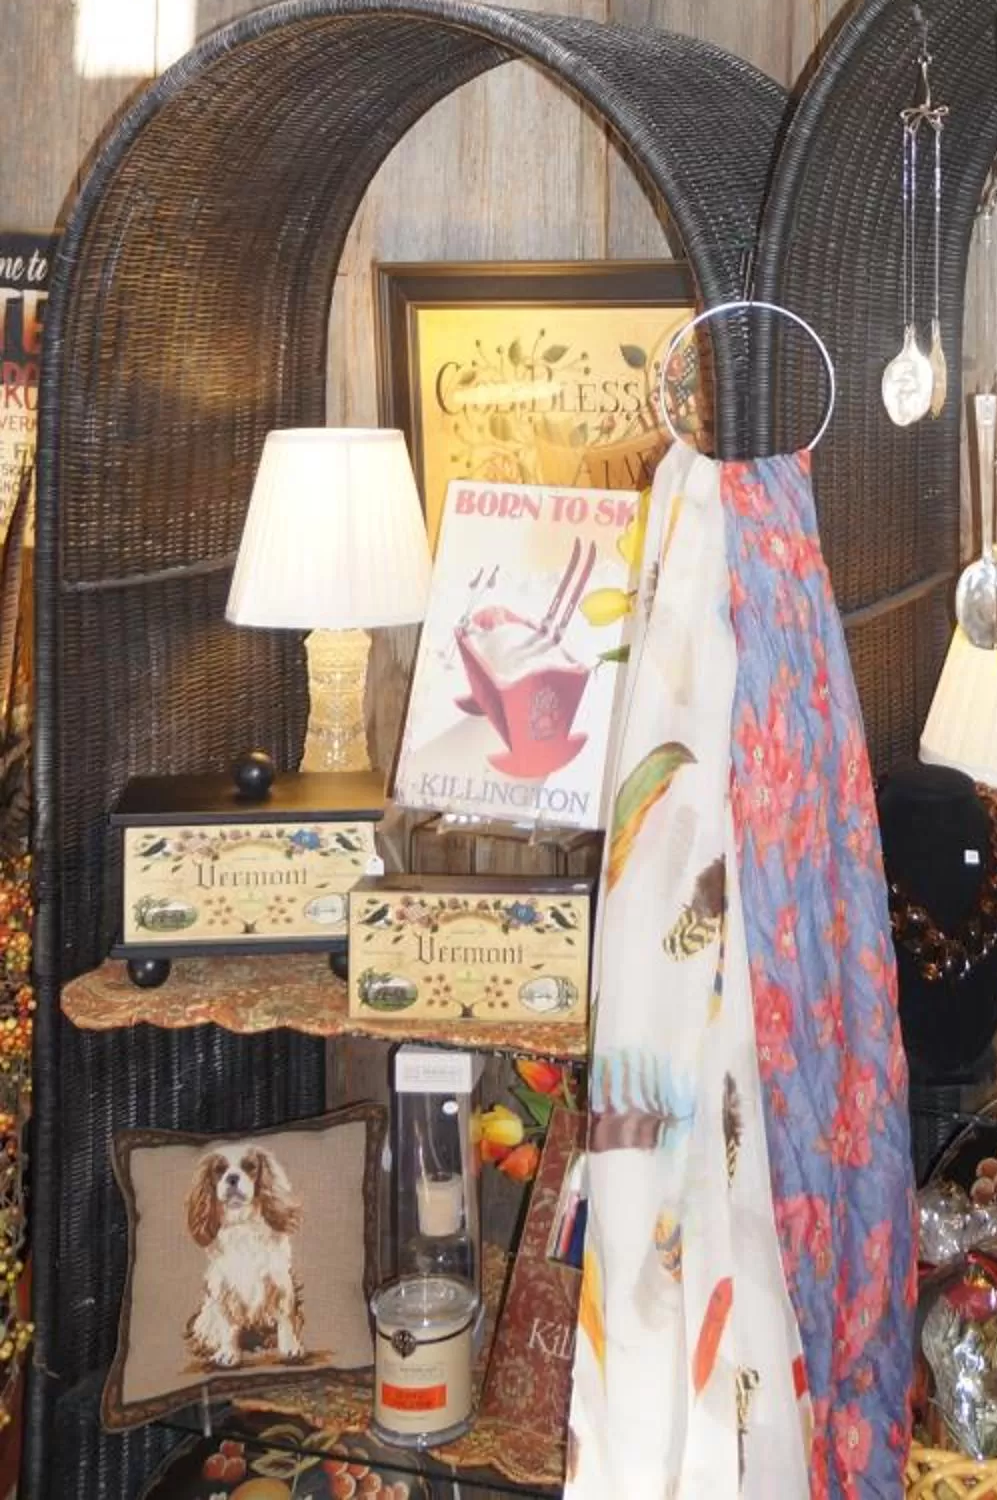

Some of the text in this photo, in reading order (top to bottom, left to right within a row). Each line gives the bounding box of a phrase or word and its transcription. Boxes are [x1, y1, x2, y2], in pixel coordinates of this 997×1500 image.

[455, 488, 636, 528] BORN TO SK
[418, 772, 591, 817] KILLINGTON
[193, 858, 308, 889] Vermont
[414, 930, 524, 964] Vermont
